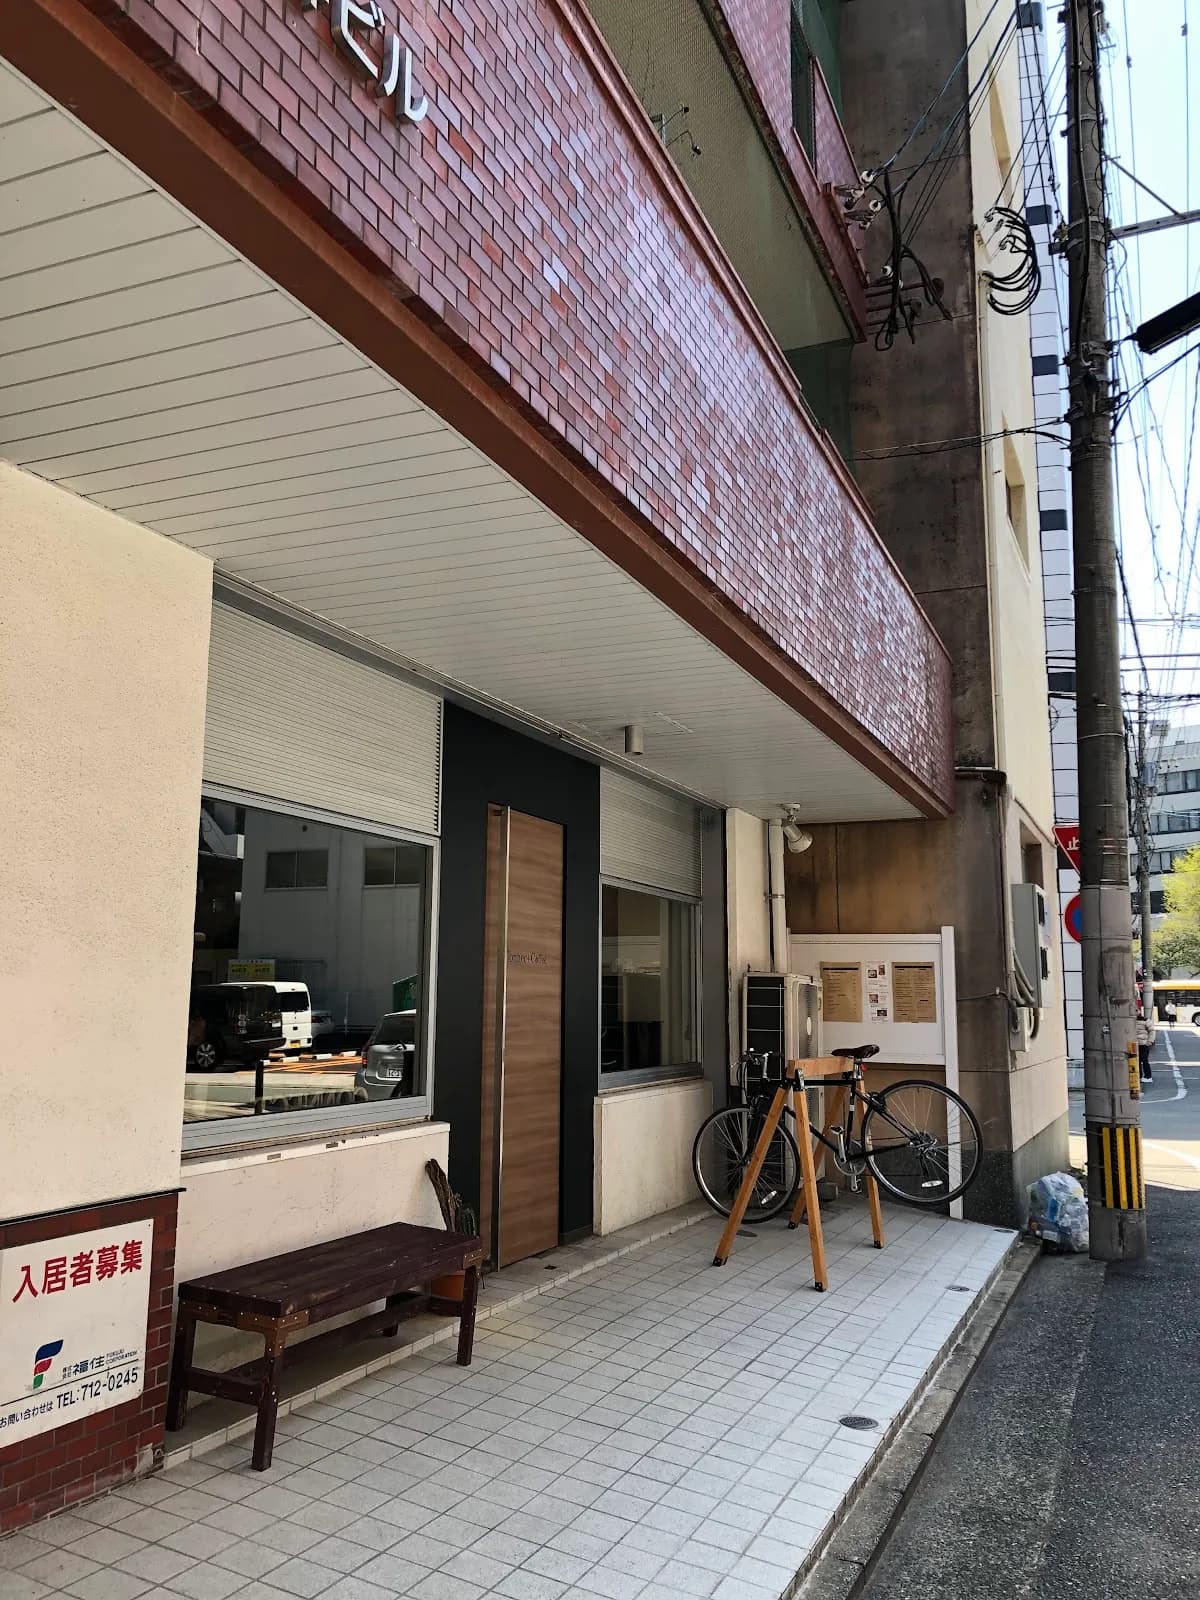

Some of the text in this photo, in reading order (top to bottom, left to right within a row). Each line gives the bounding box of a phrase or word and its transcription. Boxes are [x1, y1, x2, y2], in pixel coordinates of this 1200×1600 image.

[303, 0, 429, 122] ビル
[12, 1239, 143, 1303] 入居者募集
[0, 1402, 53, 1429] お問い合わせは
